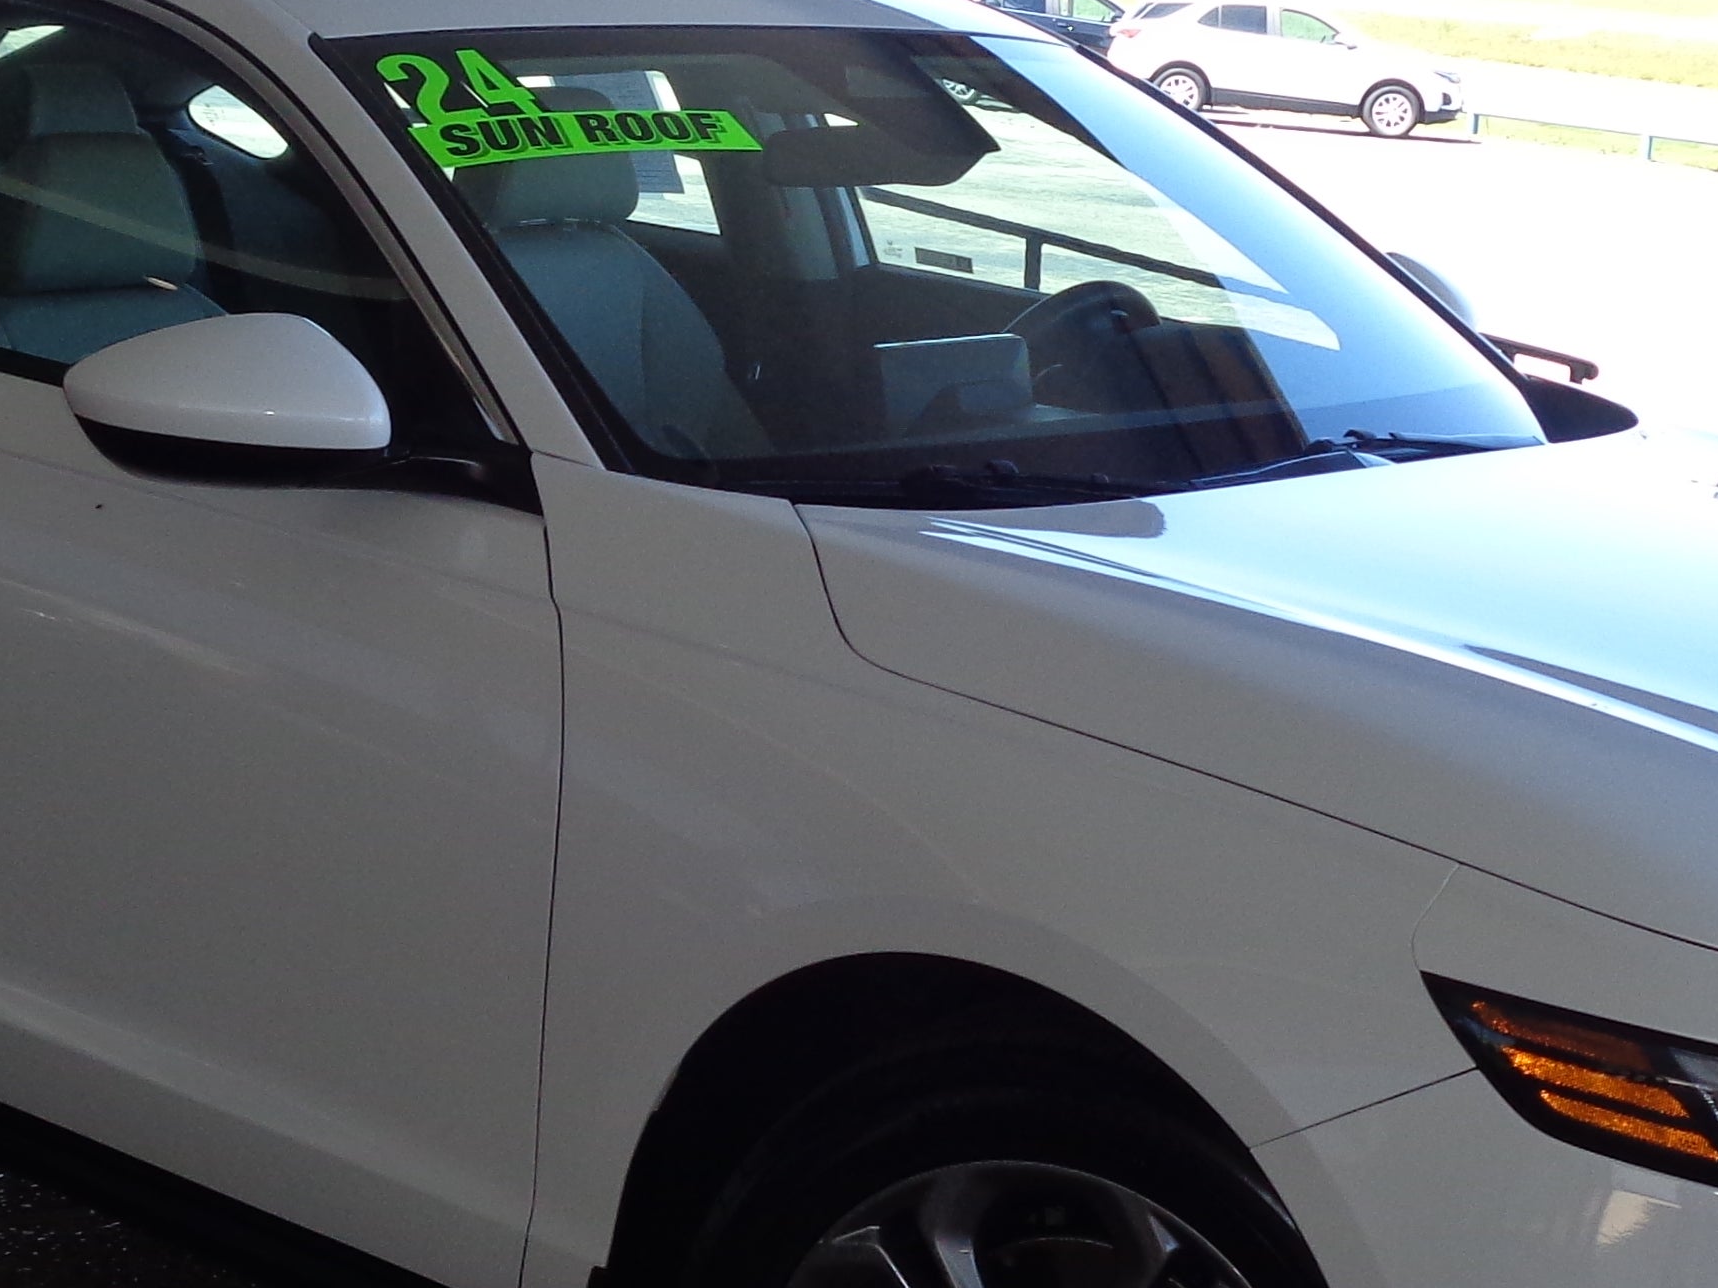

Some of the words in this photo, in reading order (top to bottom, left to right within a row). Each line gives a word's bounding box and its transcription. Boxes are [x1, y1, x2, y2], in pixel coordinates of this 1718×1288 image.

[376, 48, 543, 125] 24
[439, 115, 571, 158] SUN
[574, 112, 728, 146] ROOF
